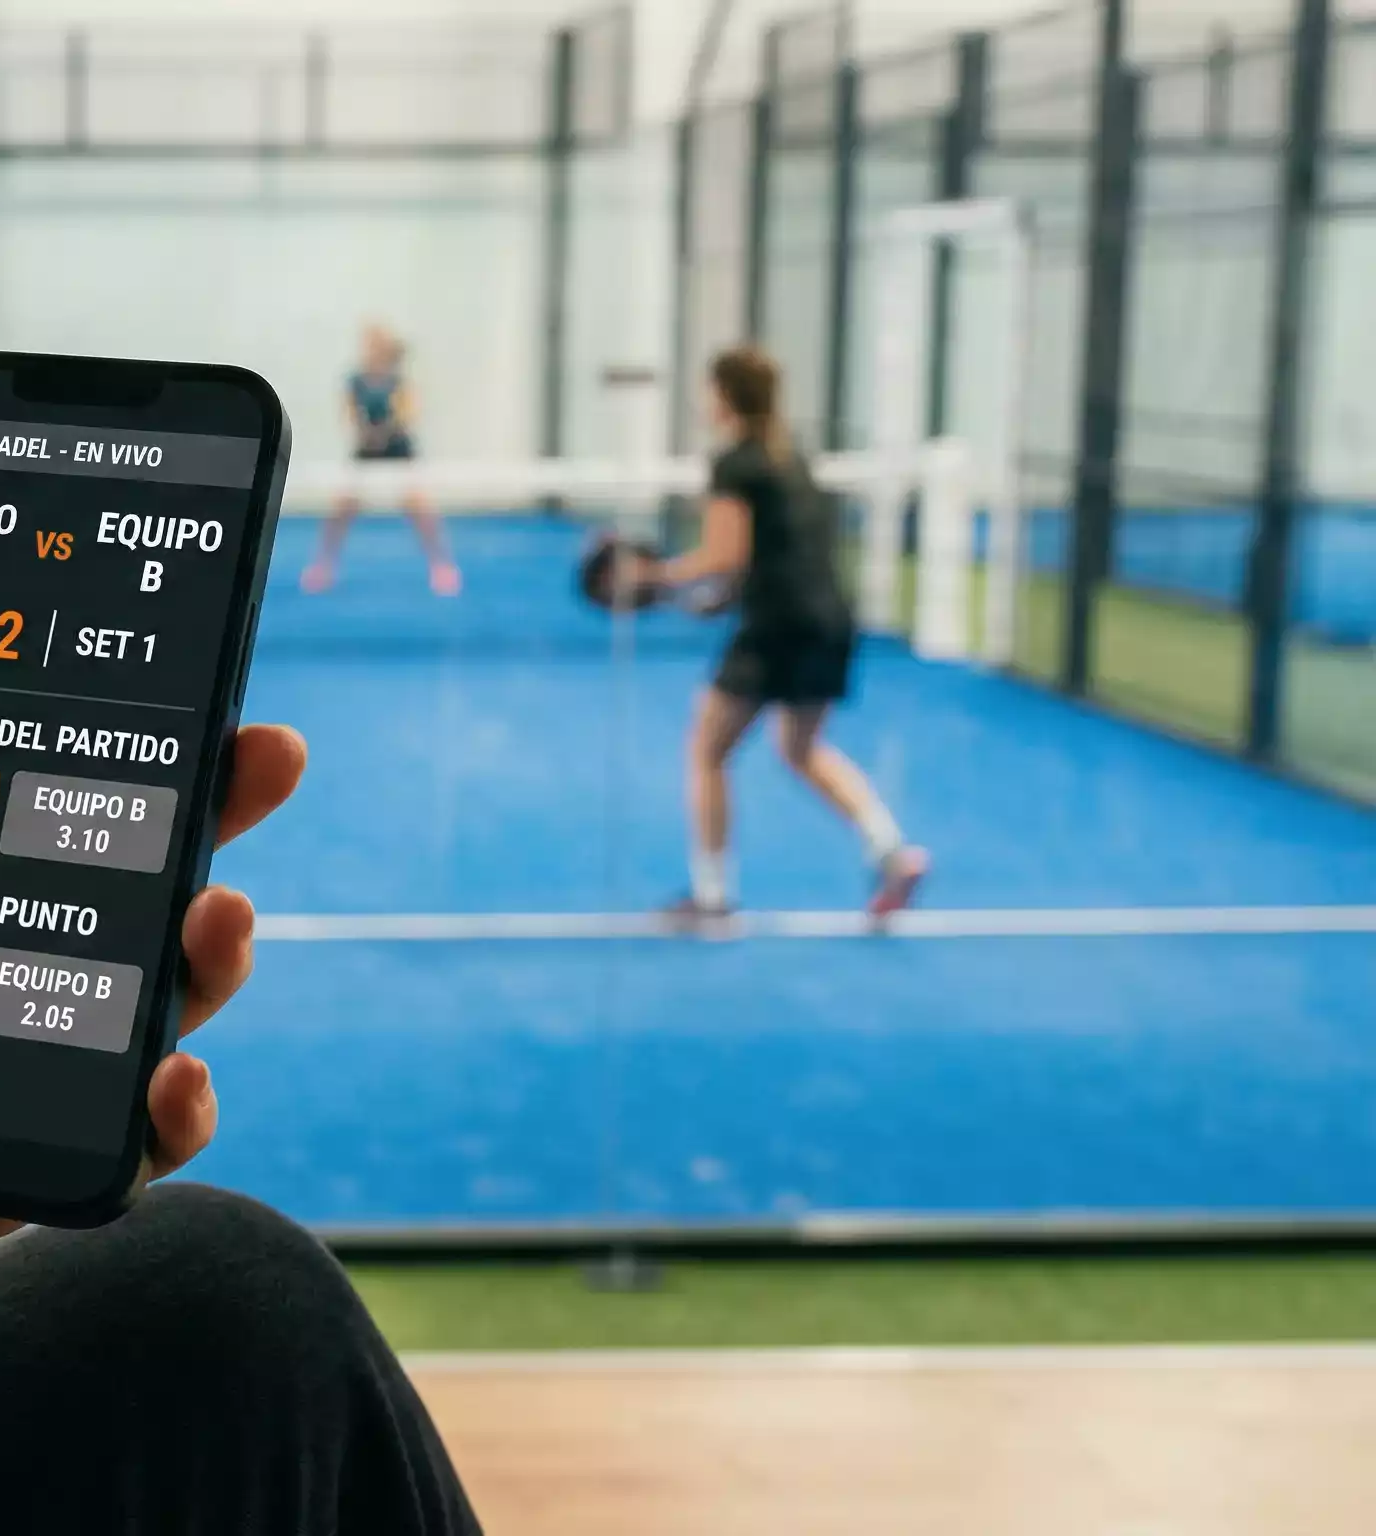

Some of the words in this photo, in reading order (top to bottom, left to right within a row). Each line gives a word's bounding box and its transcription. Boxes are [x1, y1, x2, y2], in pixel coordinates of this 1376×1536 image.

[74, 442, 103, 462] EN
[112, 444, 162, 466] VIVO
[37, 531, 73, 560] VS
[97, 512, 222, 551] EQUIPO
[140, 561, 163, 592] B
[76, 627, 134, 659] SET
[144, 634, 155, 662] 1
[56, 726, 178, 764] PARTIDO
[34, 787, 123, 818] EQUIPO
[130, 798, 146, 821] B
[57, 826, 109, 852] 3.10
[0, 897, 97, 935] PUNTO
[0, 962, 88, 996] EQUIPO
[95, 976, 111, 999] B
[21, 1002, 75, 1030] 2.05
